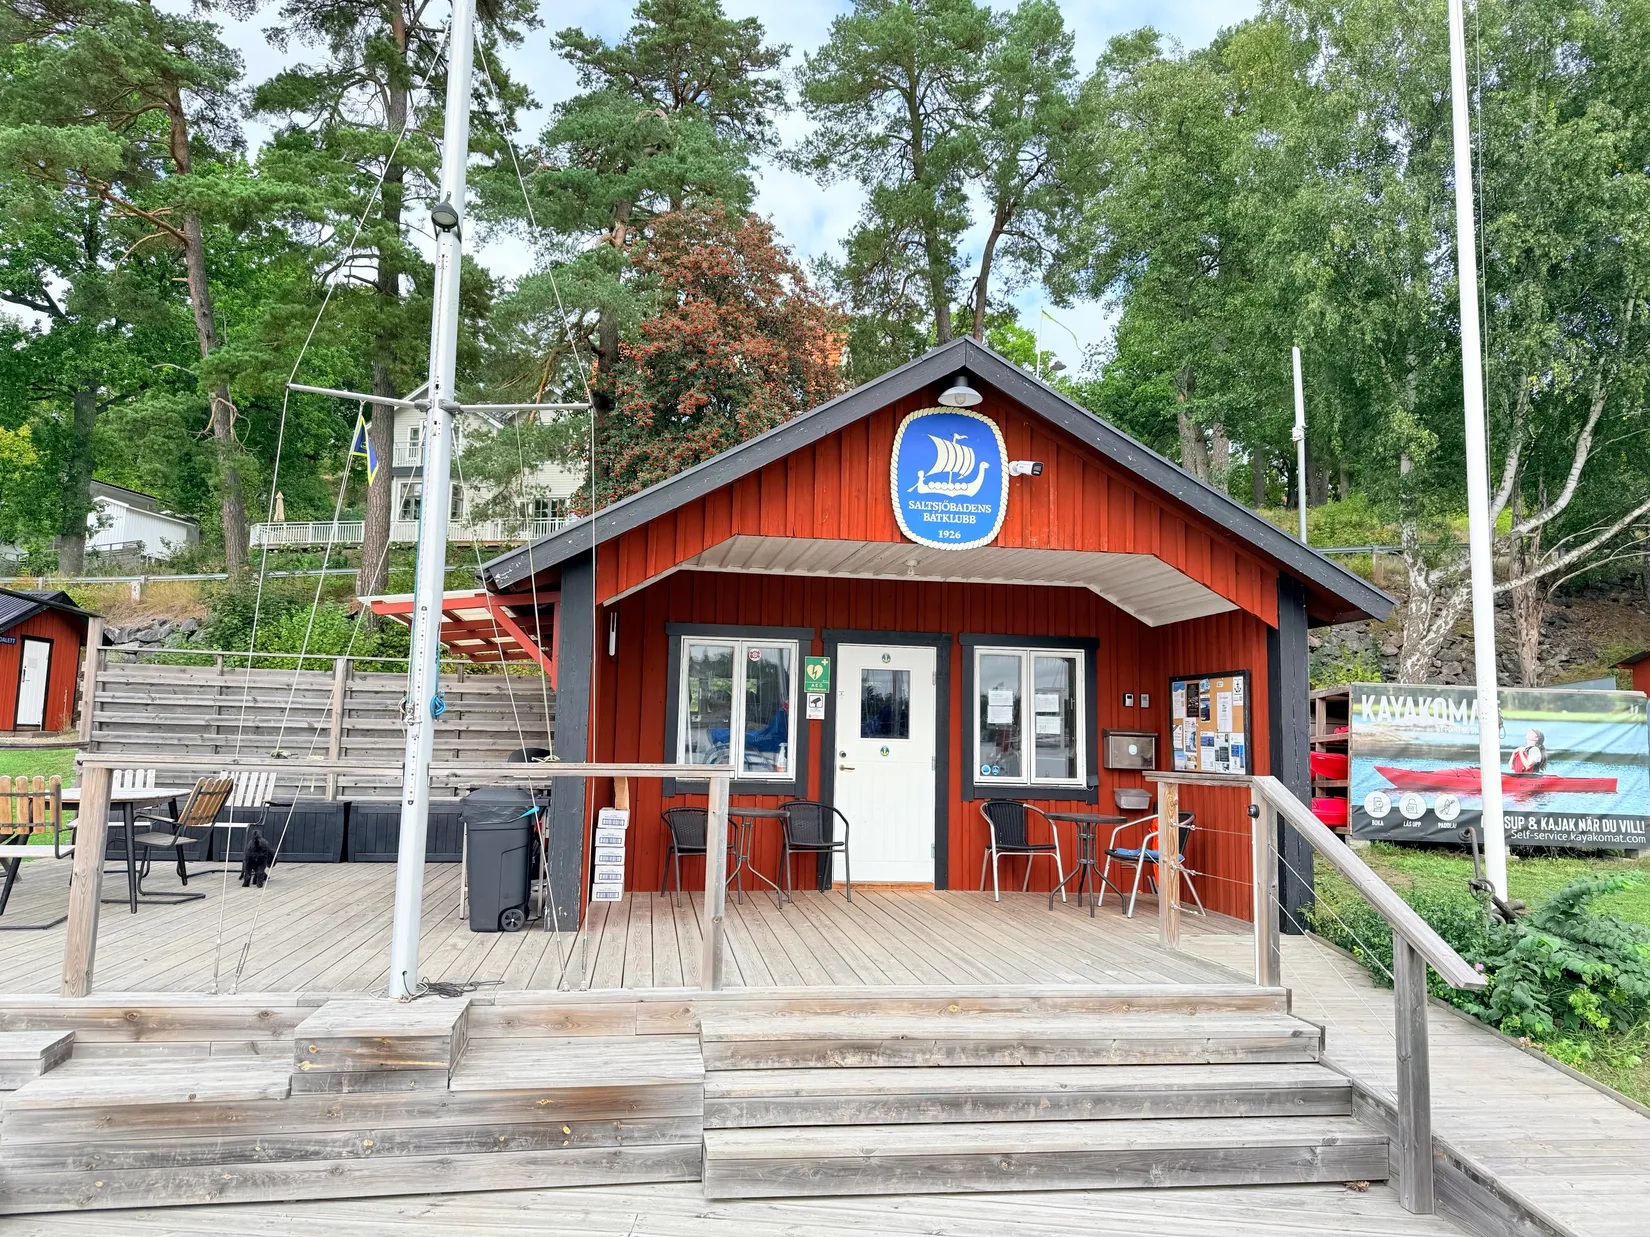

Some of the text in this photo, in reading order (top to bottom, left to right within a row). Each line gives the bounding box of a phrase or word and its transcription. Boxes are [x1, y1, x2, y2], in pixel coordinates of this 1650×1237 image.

[908, 500, 992, 513] SALTSJÖBADENS
[923, 511, 977, 524] BÅTKLUBB
[938, 529, 961, 539] 1926
[1361, 694, 1479, 726] KAYAKOMA
[1371, 819, 1385, 827] BOKA
[1504, 815, 1646, 834] SUP & KAJAK NÄR DU VILL!
[1511, 829, 1647, 845] Self-service kayakomat.com
